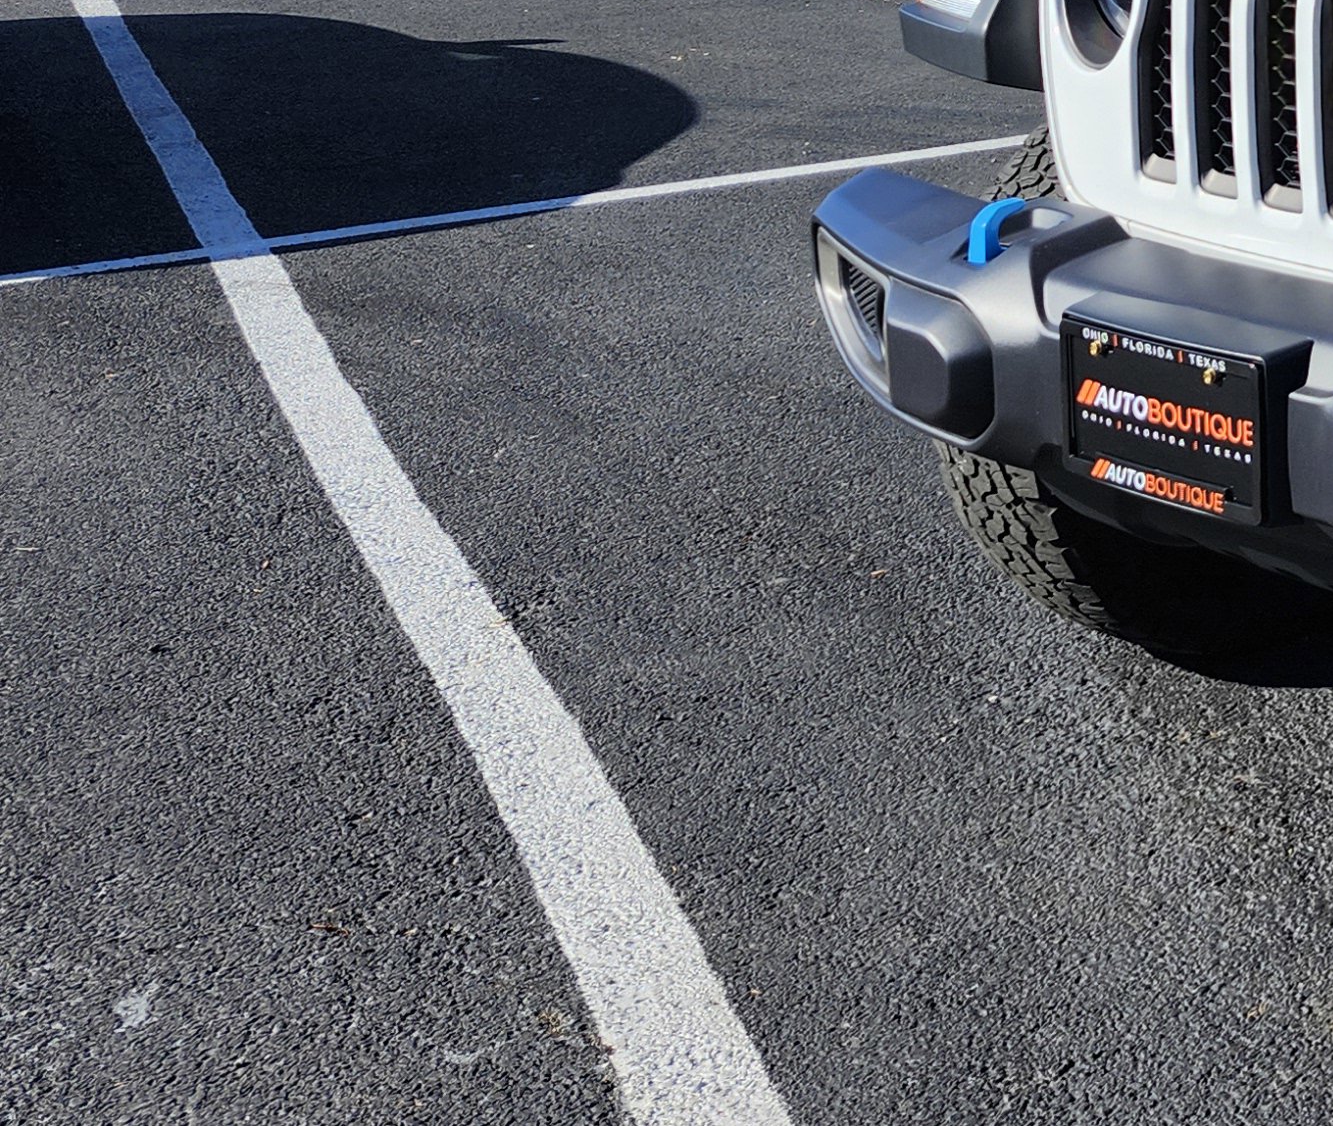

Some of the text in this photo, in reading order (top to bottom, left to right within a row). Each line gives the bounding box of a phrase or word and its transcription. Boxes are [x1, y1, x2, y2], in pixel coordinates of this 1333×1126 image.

[1082, 327, 1227, 373] OHIO FLORIDA TEXAS
[1081, 410, 1252, 464] OHIO FLORIDA TEXAS
[1093, 385, 1254, 447] AUTOBOUTIQUE
[1104, 463, 1225, 514] AUTOBOUTIQUE
